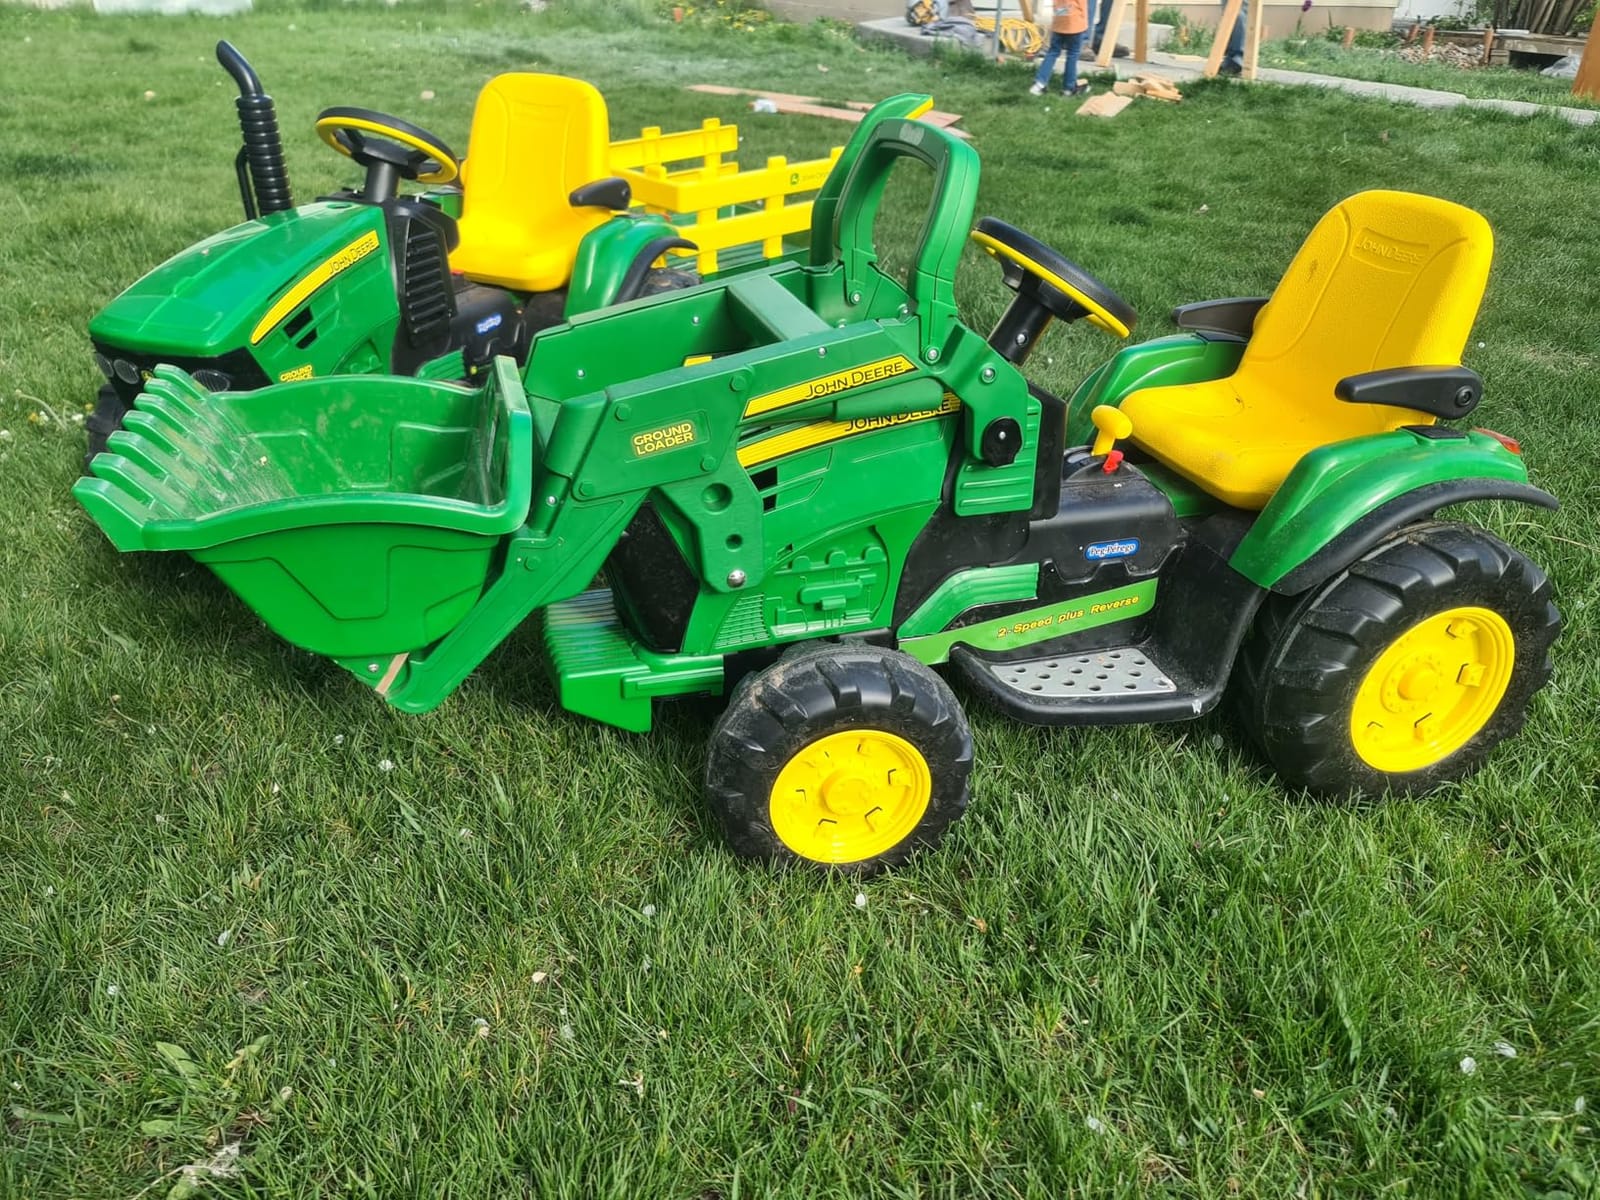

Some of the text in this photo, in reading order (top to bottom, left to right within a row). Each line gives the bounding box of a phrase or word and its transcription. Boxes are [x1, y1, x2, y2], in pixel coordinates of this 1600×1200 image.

[806, 361, 904, 398] JOHN DEERE
[633, 423, 692, 445] GROUND
[845, 414, 893, 432] JOHN
[636, 432, 694, 455] LOADER
[1057, 609, 1085, 624] plus
[1090, 596, 1140, 615] Reverse
